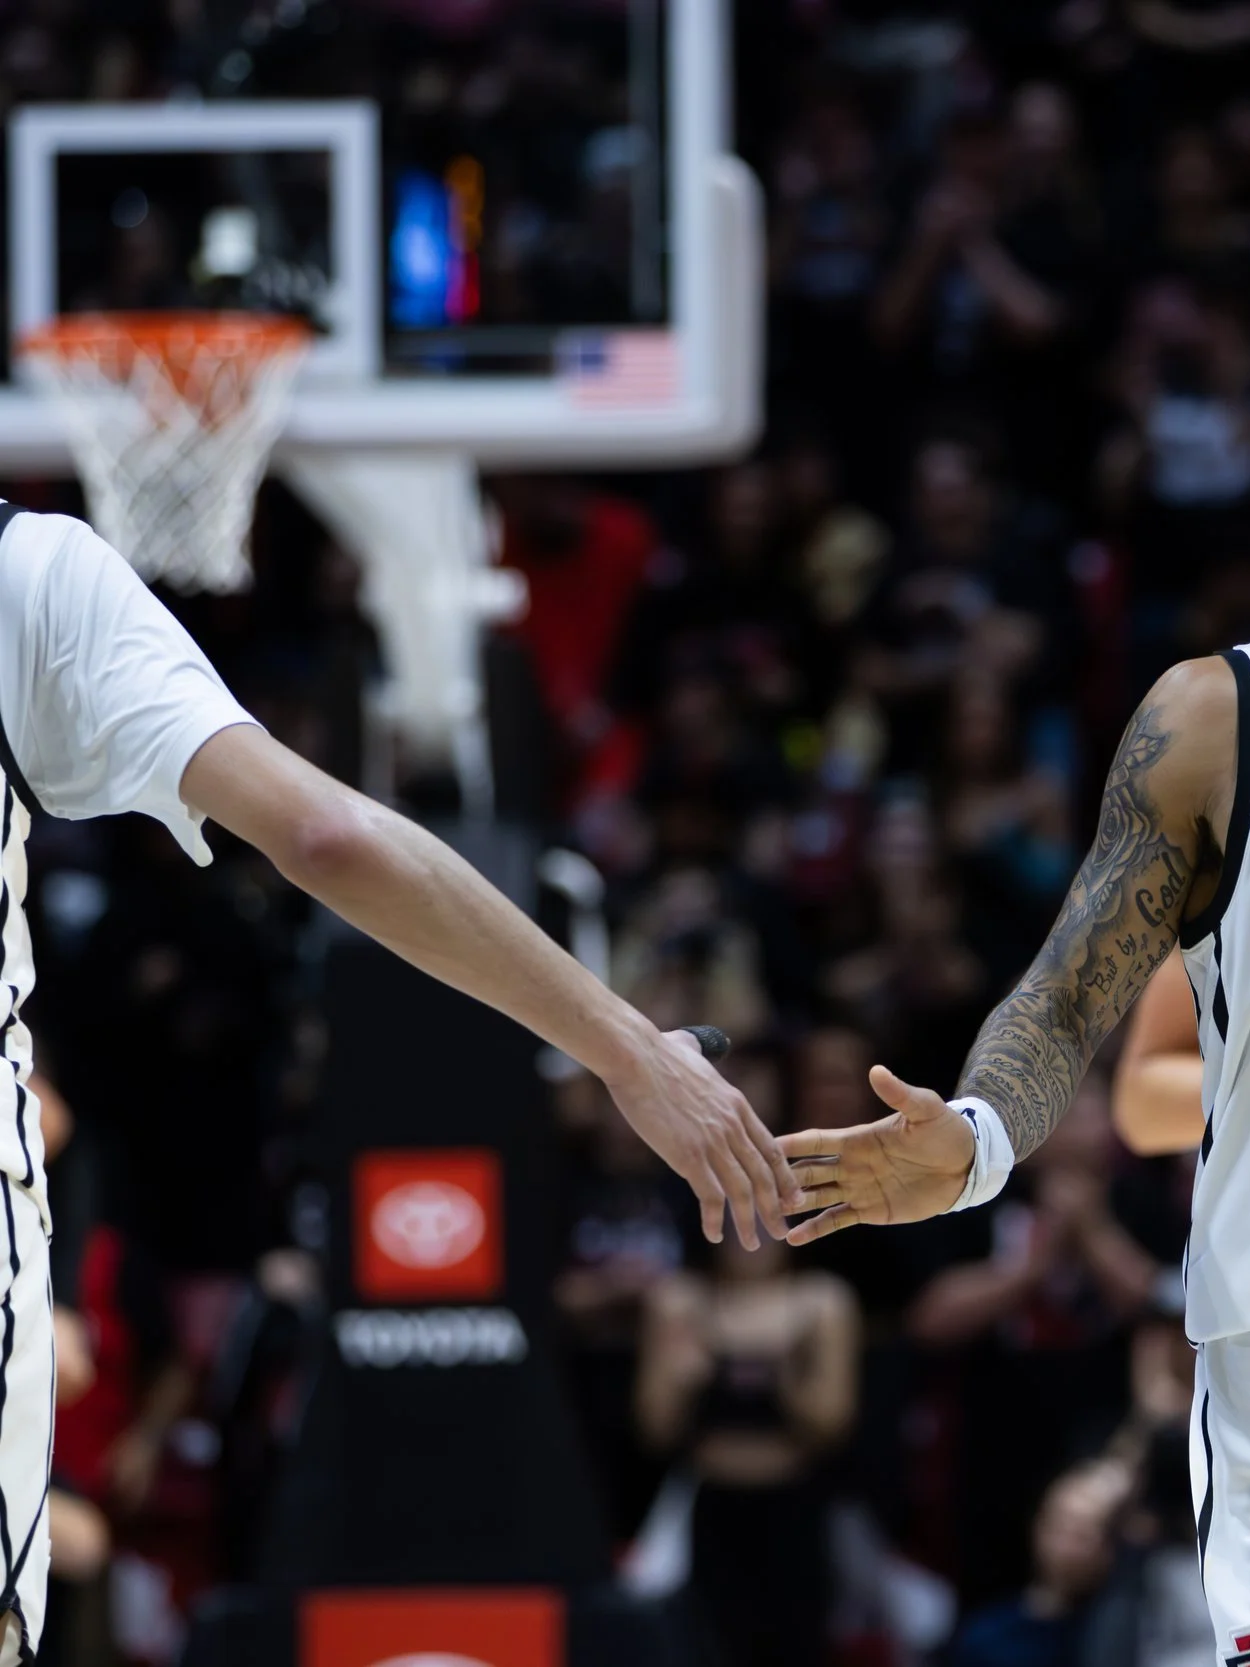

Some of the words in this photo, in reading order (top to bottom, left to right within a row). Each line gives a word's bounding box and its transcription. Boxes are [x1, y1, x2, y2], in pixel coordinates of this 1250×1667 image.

[1136, 852, 1187, 928] God
[1086, 954, 1119, 995] But
[1116, 933, 1137, 956] by
[1000, 1029, 1041, 1057] FROM
